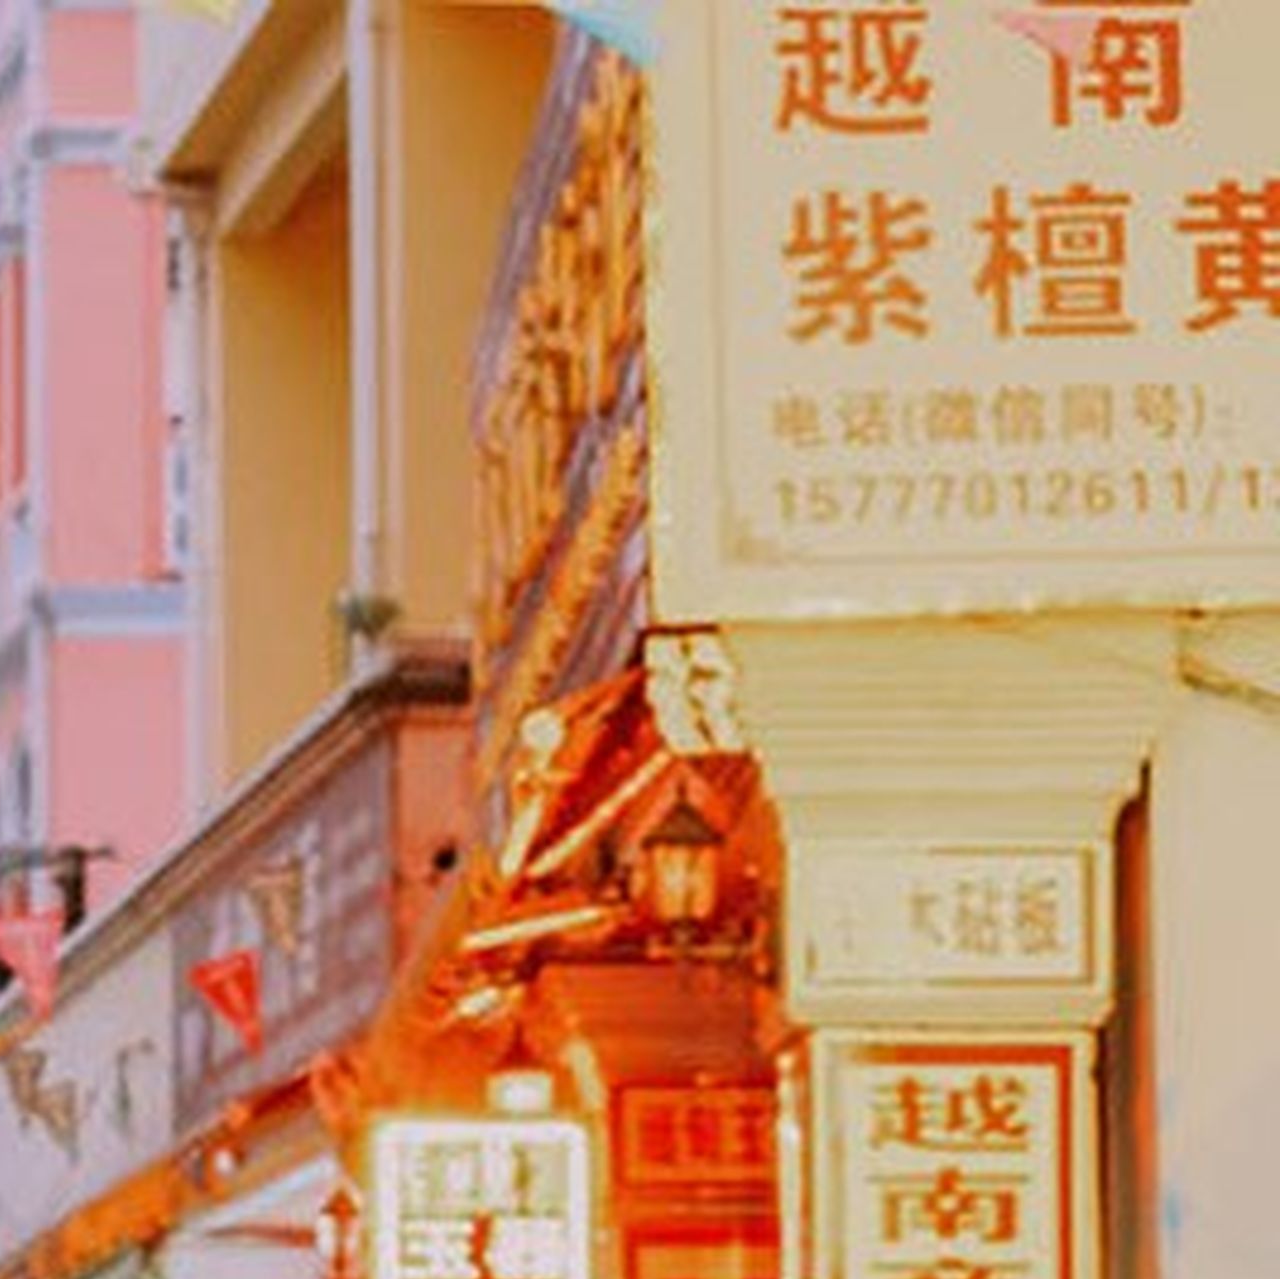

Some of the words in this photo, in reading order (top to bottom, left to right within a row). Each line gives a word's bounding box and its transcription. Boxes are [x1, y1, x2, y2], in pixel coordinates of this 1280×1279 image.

[775, 0, 1191, 133] 越南
[773, 178, 1280, 345] 紫檀黄
[775, 465, 1280, 522] 15777012611/1
